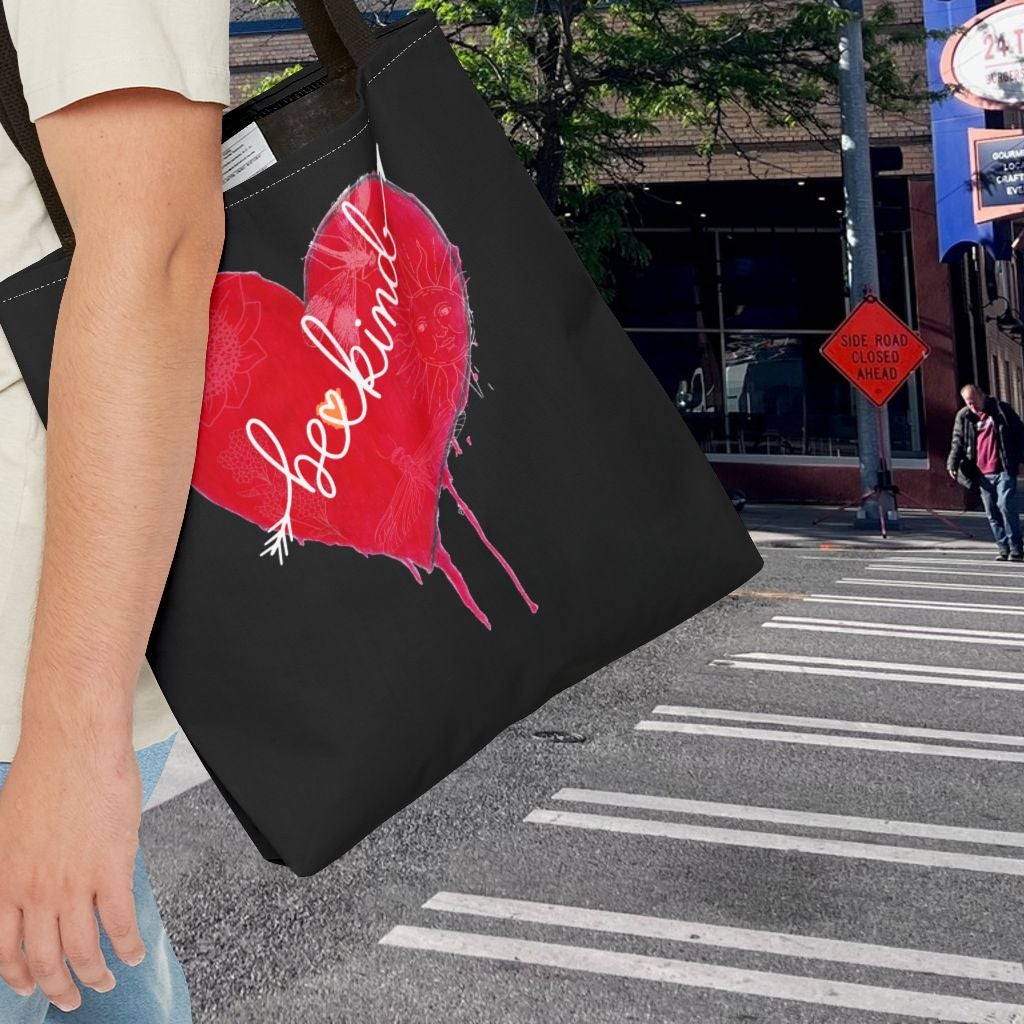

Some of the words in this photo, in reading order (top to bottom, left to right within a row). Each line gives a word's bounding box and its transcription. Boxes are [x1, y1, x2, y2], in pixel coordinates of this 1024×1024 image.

[983, 32, 1010, 61] 24
[841, 334, 868, 347] SIDE
[875, 333, 908, 347] ROAD
[246, 416, 352, 519] be
[301, 201, 398, 400] kind
[852, 350, 900, 364] CLOSED
[858, 367, 897, 380] AHEAD
